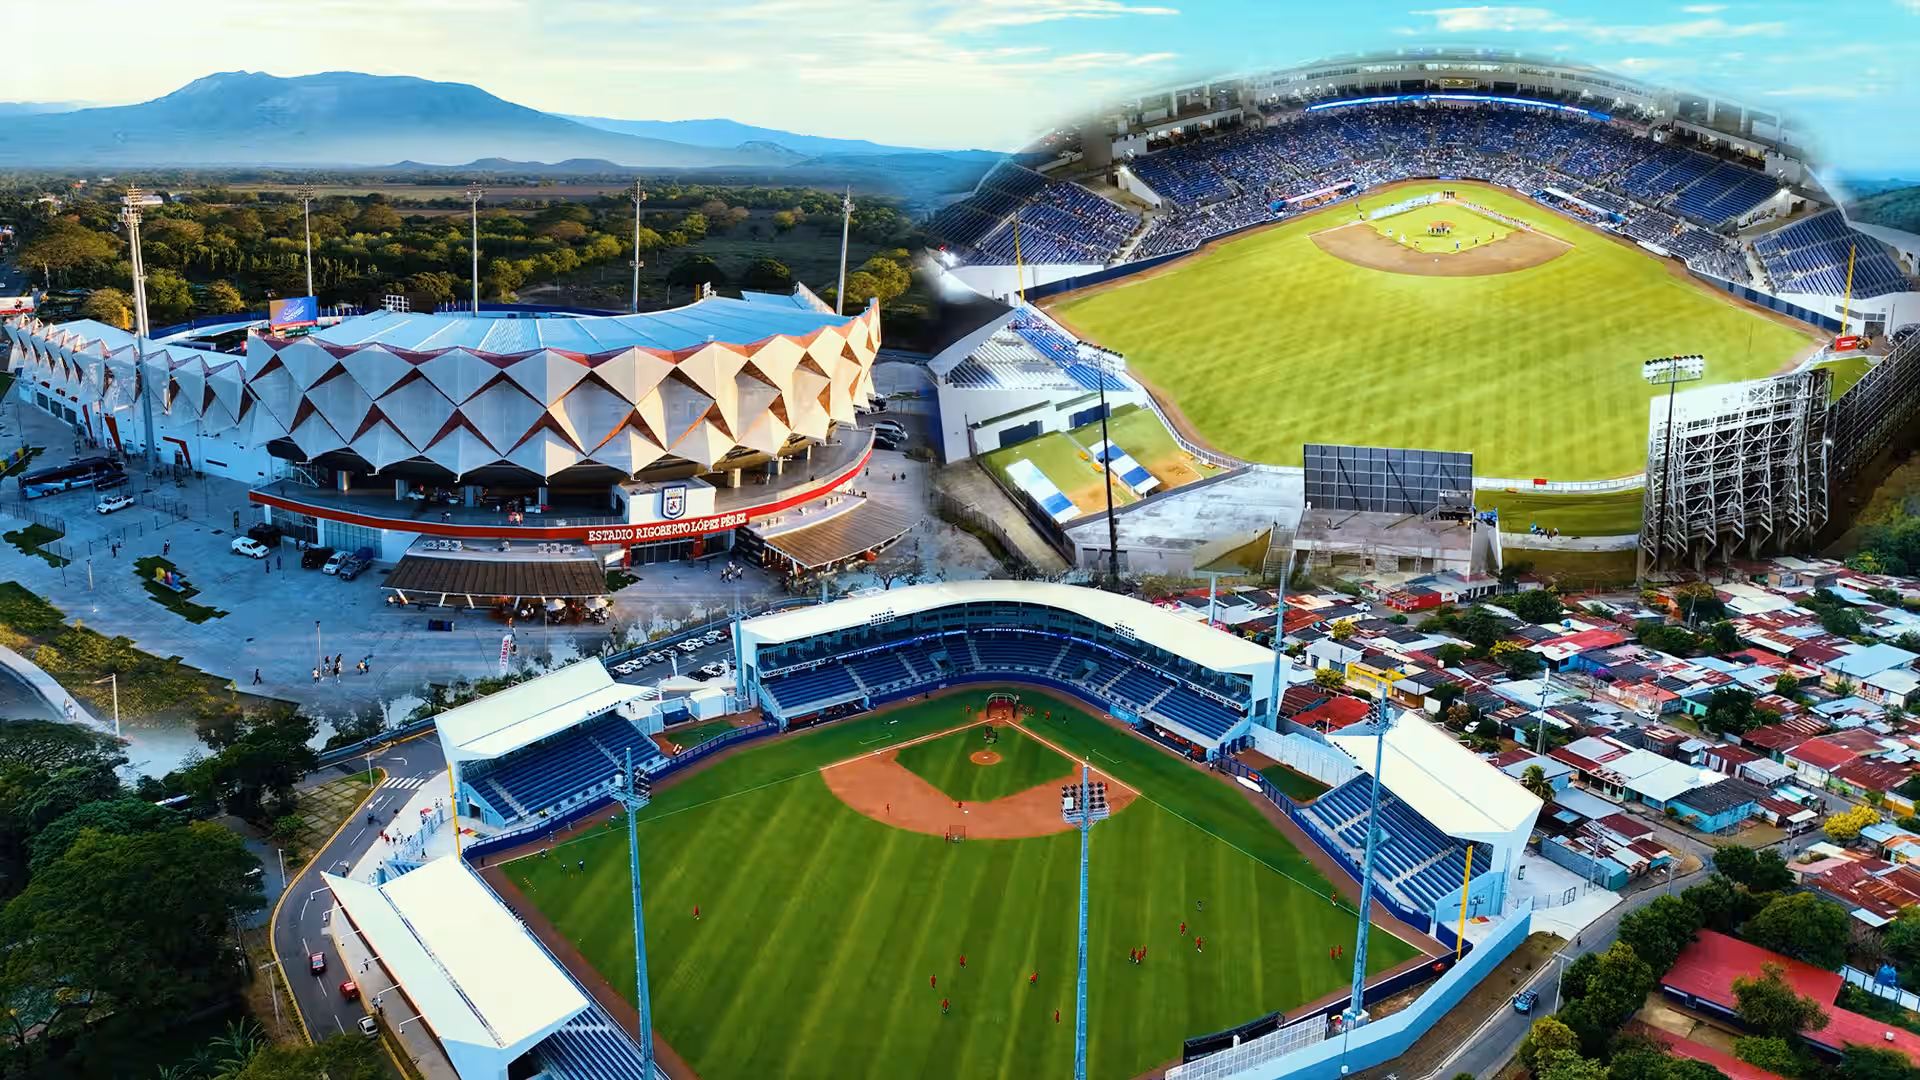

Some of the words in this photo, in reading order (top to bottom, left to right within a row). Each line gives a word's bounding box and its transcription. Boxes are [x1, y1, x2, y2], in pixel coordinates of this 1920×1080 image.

[588, 529, 634, 541] ESTADIO
[636, 522, 690, 539] RIGOBERTO
[690, 518, 720, 533] LÓPEZ
[719, 513, 746, 528] PÉREZ
